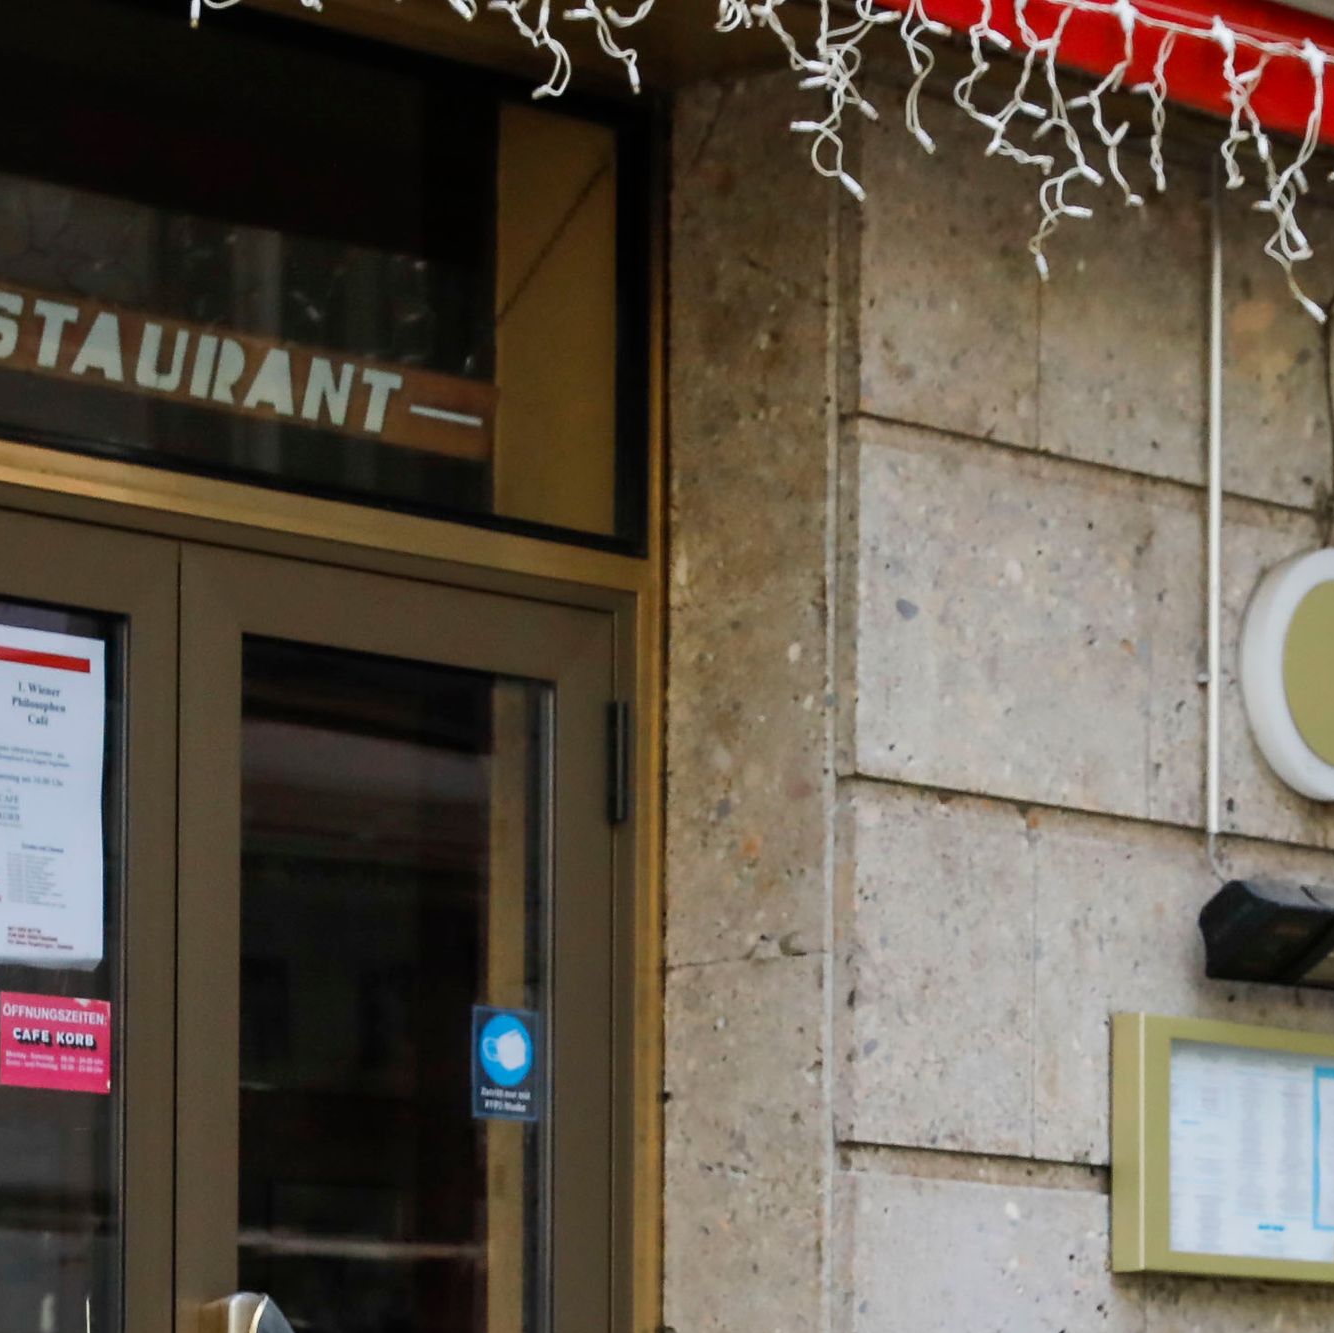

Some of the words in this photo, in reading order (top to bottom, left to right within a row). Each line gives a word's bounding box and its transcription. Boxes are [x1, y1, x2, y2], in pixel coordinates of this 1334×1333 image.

[27, 681, 60, 698] Wiener
[12, 1027, 51, 1046] CAFE
[56, 1031, 97, 1049] KORB
